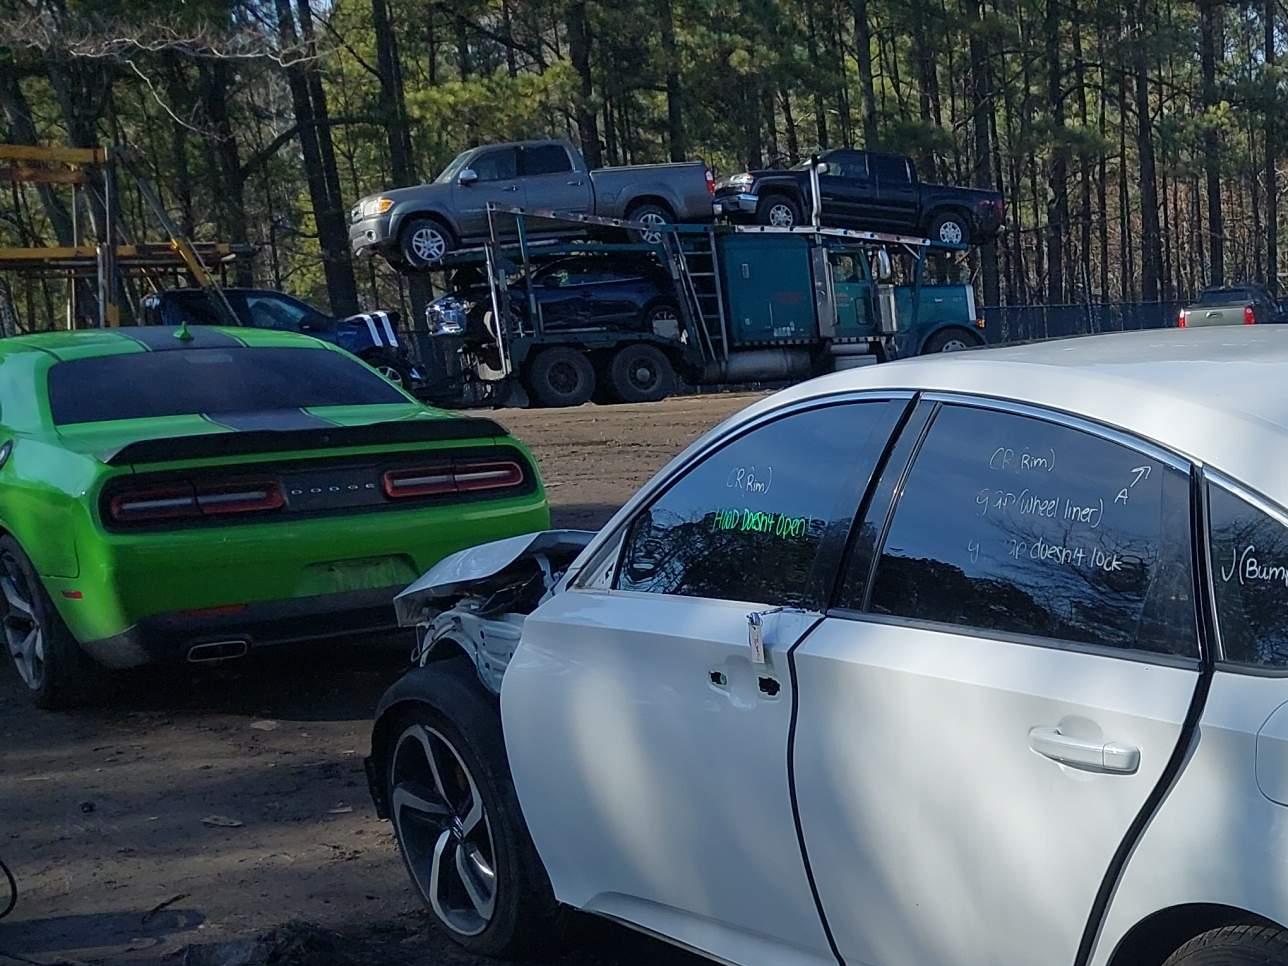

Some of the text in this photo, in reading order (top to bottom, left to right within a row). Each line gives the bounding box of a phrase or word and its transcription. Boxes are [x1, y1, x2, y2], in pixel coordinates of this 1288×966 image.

[290, 483, 375, 495] DODGE
[1114, 488, 1129, 505] A
[1090, 547, 1123, 573] lock
